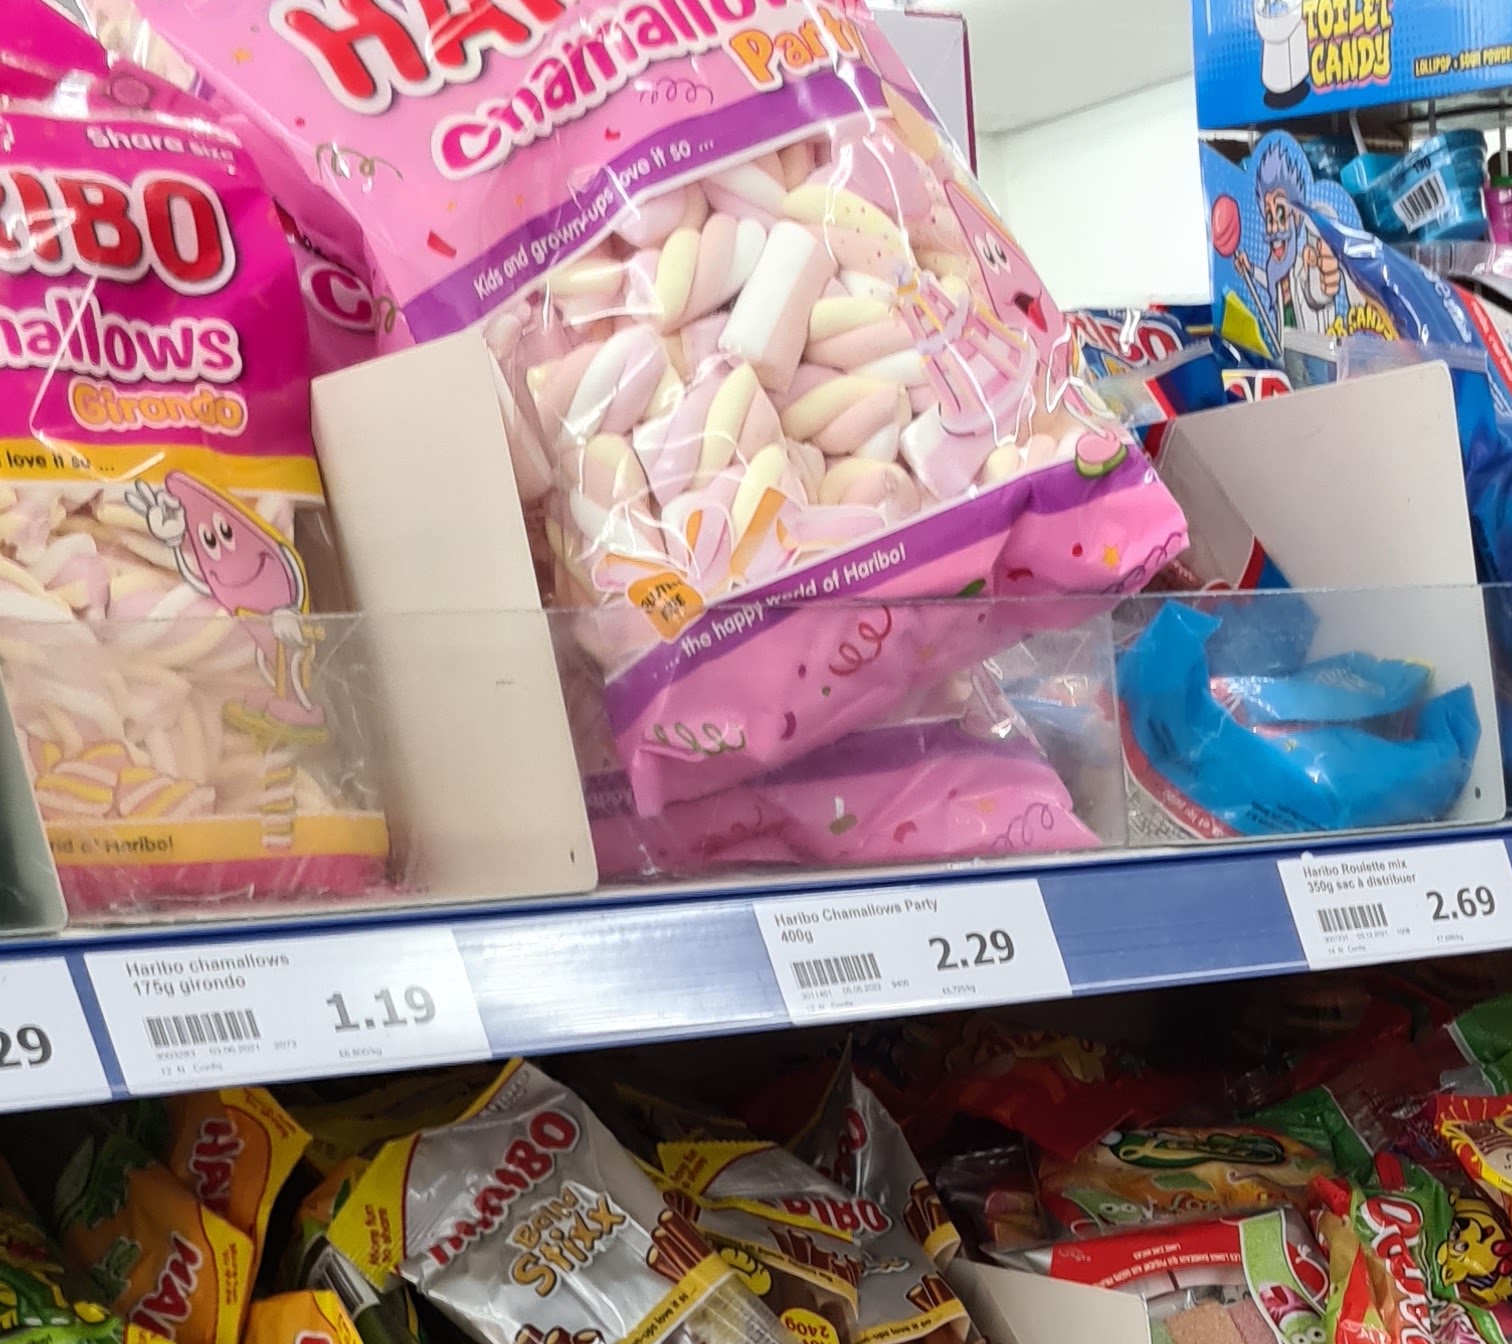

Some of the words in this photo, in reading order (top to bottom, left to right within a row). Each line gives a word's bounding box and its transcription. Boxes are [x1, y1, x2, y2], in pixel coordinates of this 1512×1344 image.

[1309, 28, 1393, 84] CANDY
[86, 126, 184, 153] Share
[473, 266, 505, 300] Kids
[503, 246, 531, 280] and
[529, 186, 615, 262] grown-ups
[681, 629, 713, 659] the
[714, 601, 765, 643] happy
[823, 569, 841, 594] of
[1302, 861, 1338, 880] Haribo
[1340, 858, 1387, 877] Roulette
[1389, 856, 1408, 872] mix
[1368, 870, 1417, 890] distribuer
[774, 908, 820, 929] Haribo
[904, 896, 939, 916] Party
[1426, 884, 1496, 922] 2.69
[126, 956, 185, 979] Haribo
[189, 951, 291, 976] chamallows
[928, 929, 1016, 973] 2.29
[178, 973, 247, 996] girondo
[325, 984, 437, 1033] 1.19
[509, 1195, 627, 1299] Stixx
